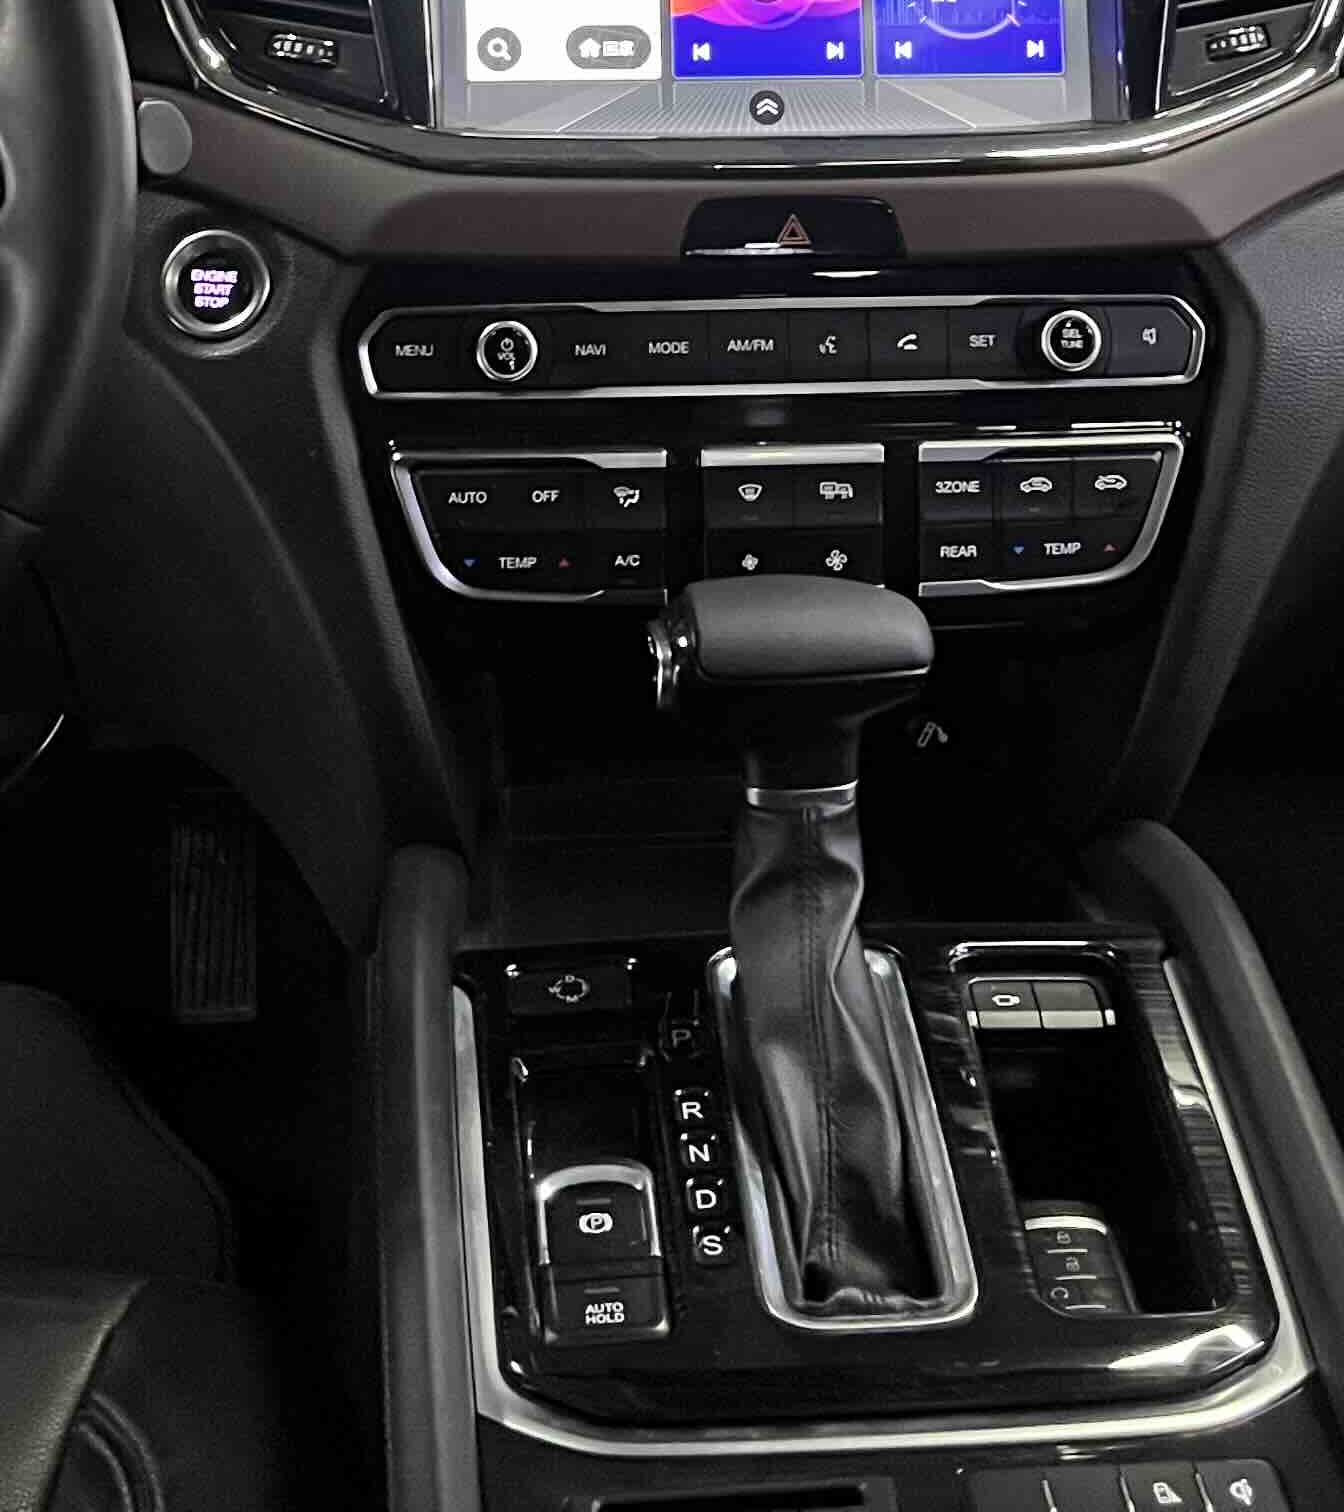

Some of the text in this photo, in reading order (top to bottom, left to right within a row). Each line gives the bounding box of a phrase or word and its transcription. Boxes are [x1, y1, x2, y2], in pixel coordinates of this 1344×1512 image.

[193, 282, 235, 297] START
[194, 295, 230, 309] STOP
[647, 340, 690, 355] MODE
[727, 338, 775, 354] AM/FM
[968, 334, 997, 349] SET
[395, 343, 434, 358] MENU
[574, 343, 607, 358] NAVI
[935, 481, 981, 494] 3ZONE
[447, 491, 488, 505] AUTO
[531, 490, 560, 504] OFF
[939, 545, 978, 559] REAR
[1043, 541, 1082, 556] TEMP
[498, 556, 537, 570] TEMP
[614, 554, 641, 568] A/C
[681, 1102, 704, 1120] R
[688, 1144, 711, 1163] N
[695, 1190, 717, 1209] D
[702, 1236, 723, 1256] S
[584, 1301, 624, 1314] AUTO
[584, 1312, 625, 1325] HOLD
